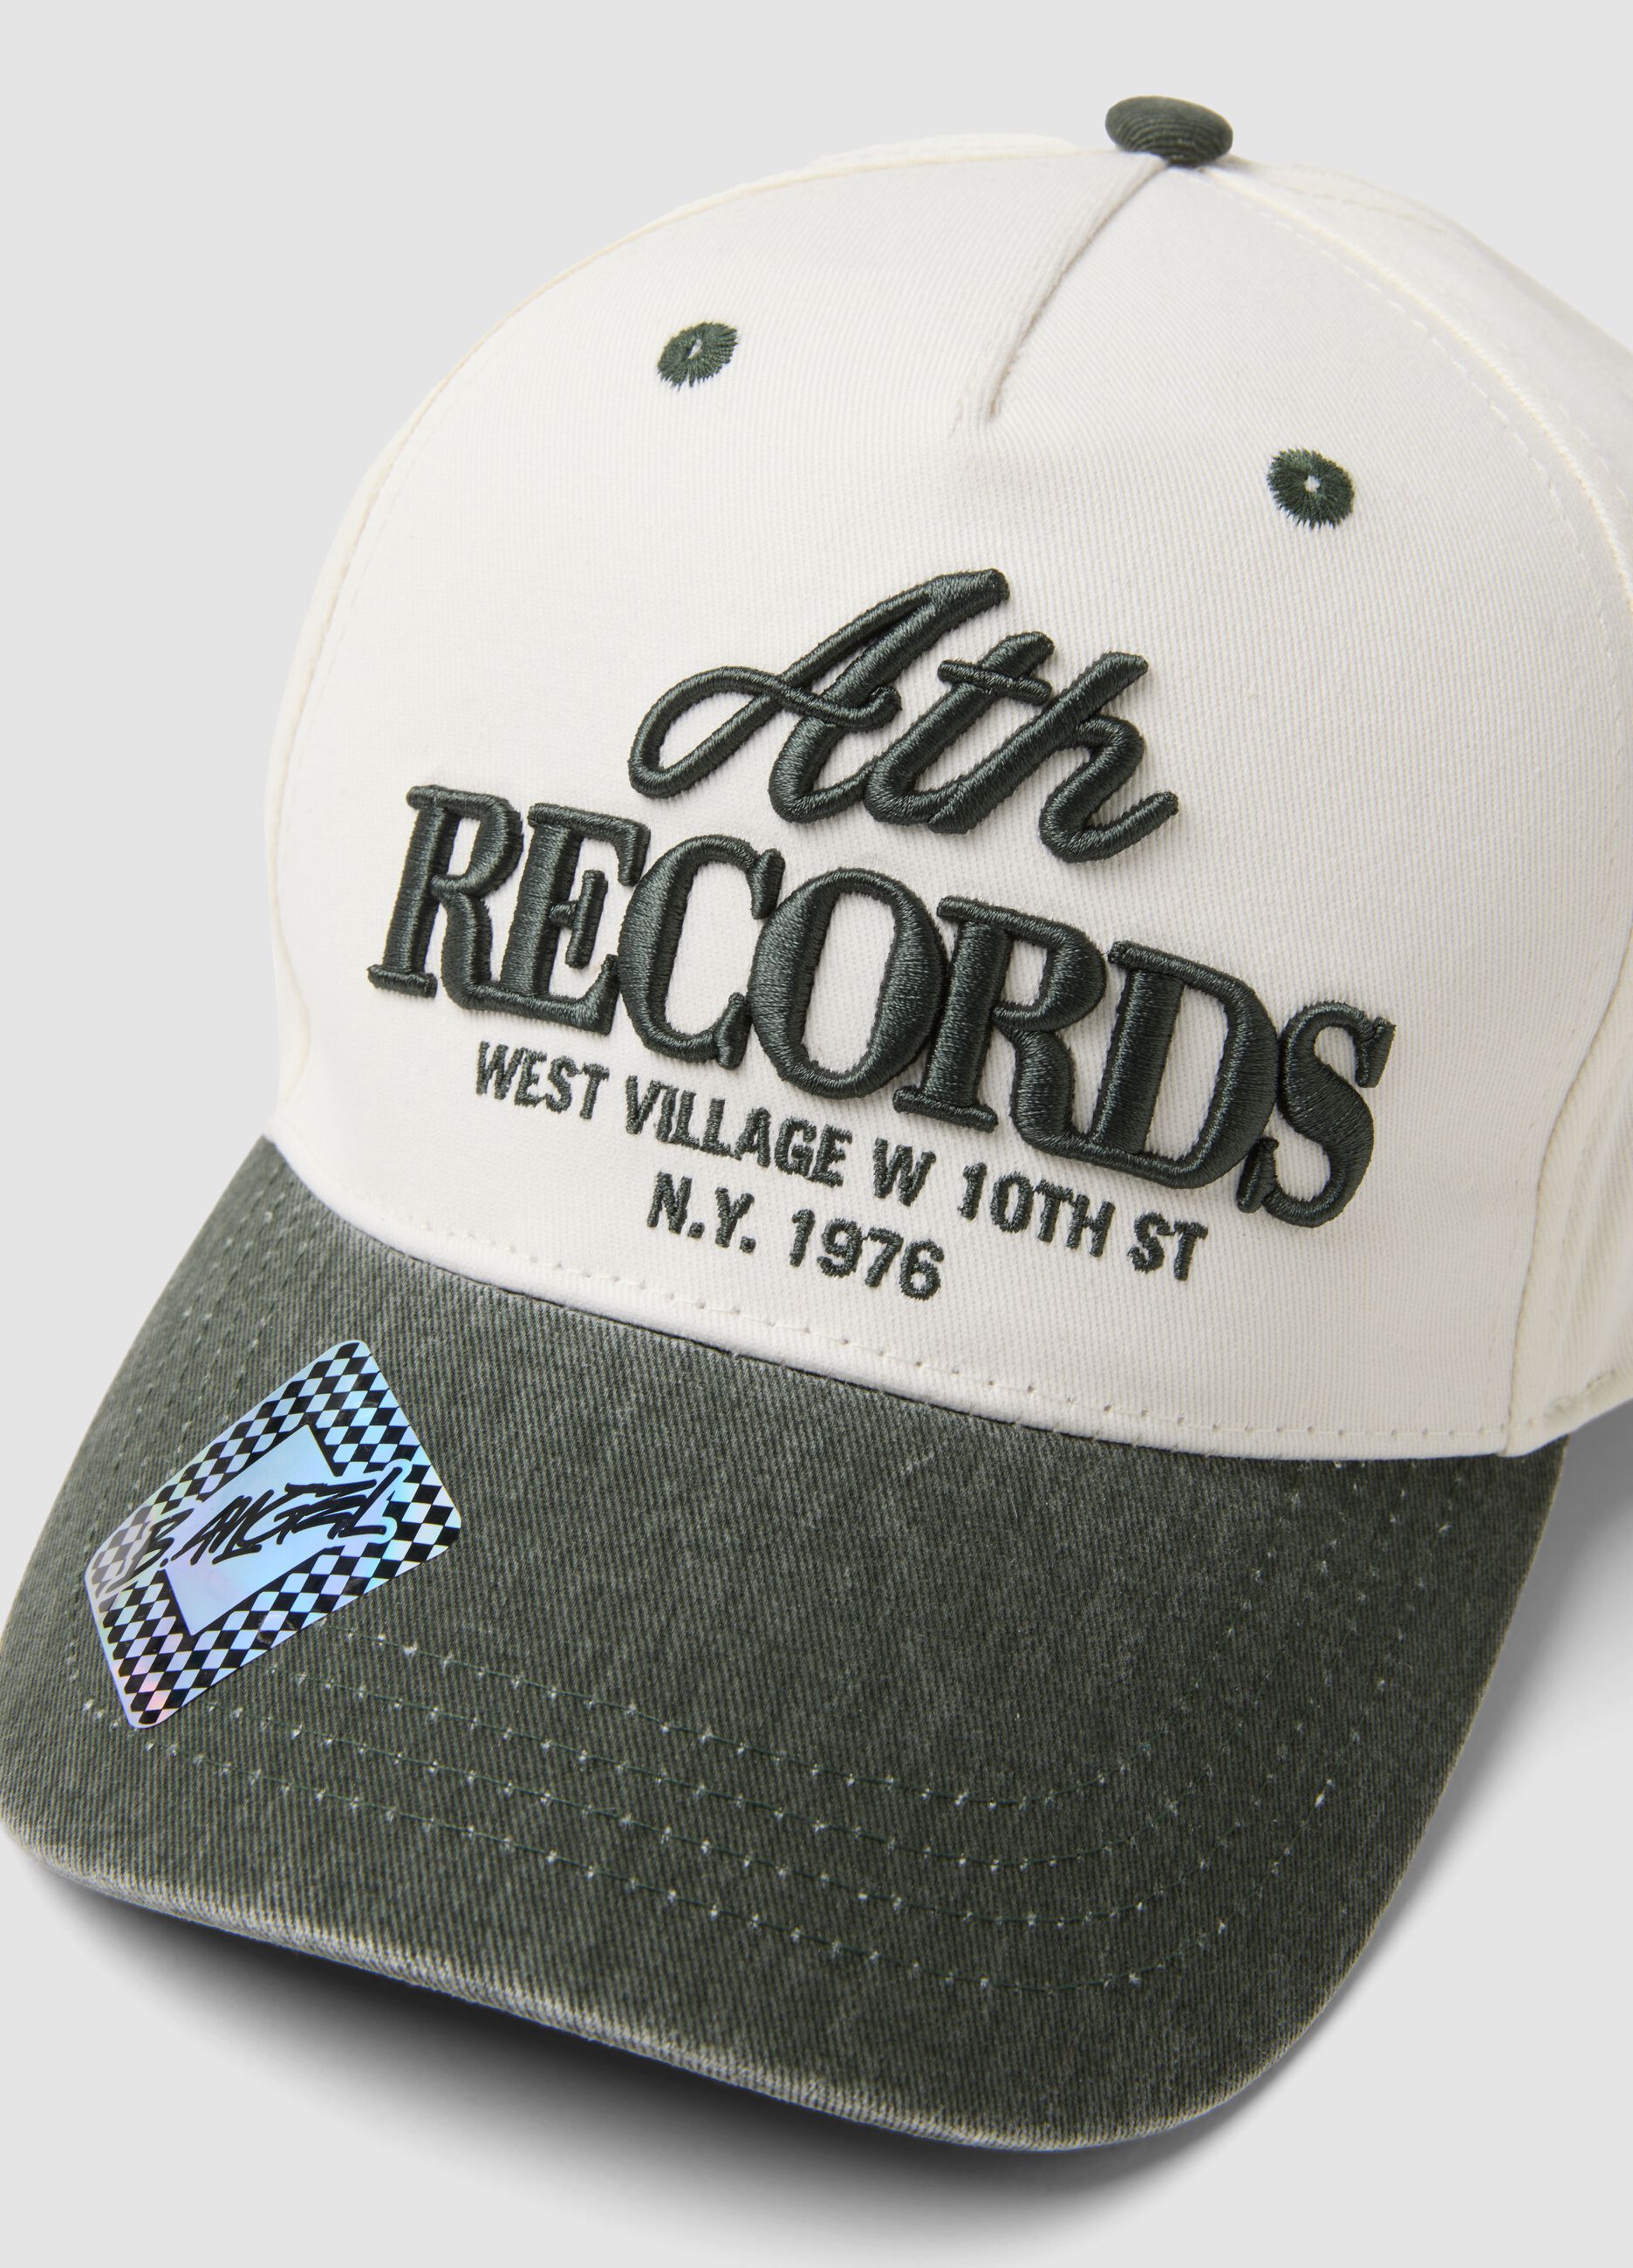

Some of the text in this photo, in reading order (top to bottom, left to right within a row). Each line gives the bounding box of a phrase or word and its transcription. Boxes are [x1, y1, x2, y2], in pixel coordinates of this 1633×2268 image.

[627, 568, 1179, 866] Ath
[366, 784, 1397, 1229] RECORDS
[475, 1040, 1209, 1281] WEST VILLAGE W 10TH ST
[646, 1171, 945, 1302] N.Y. 1976
